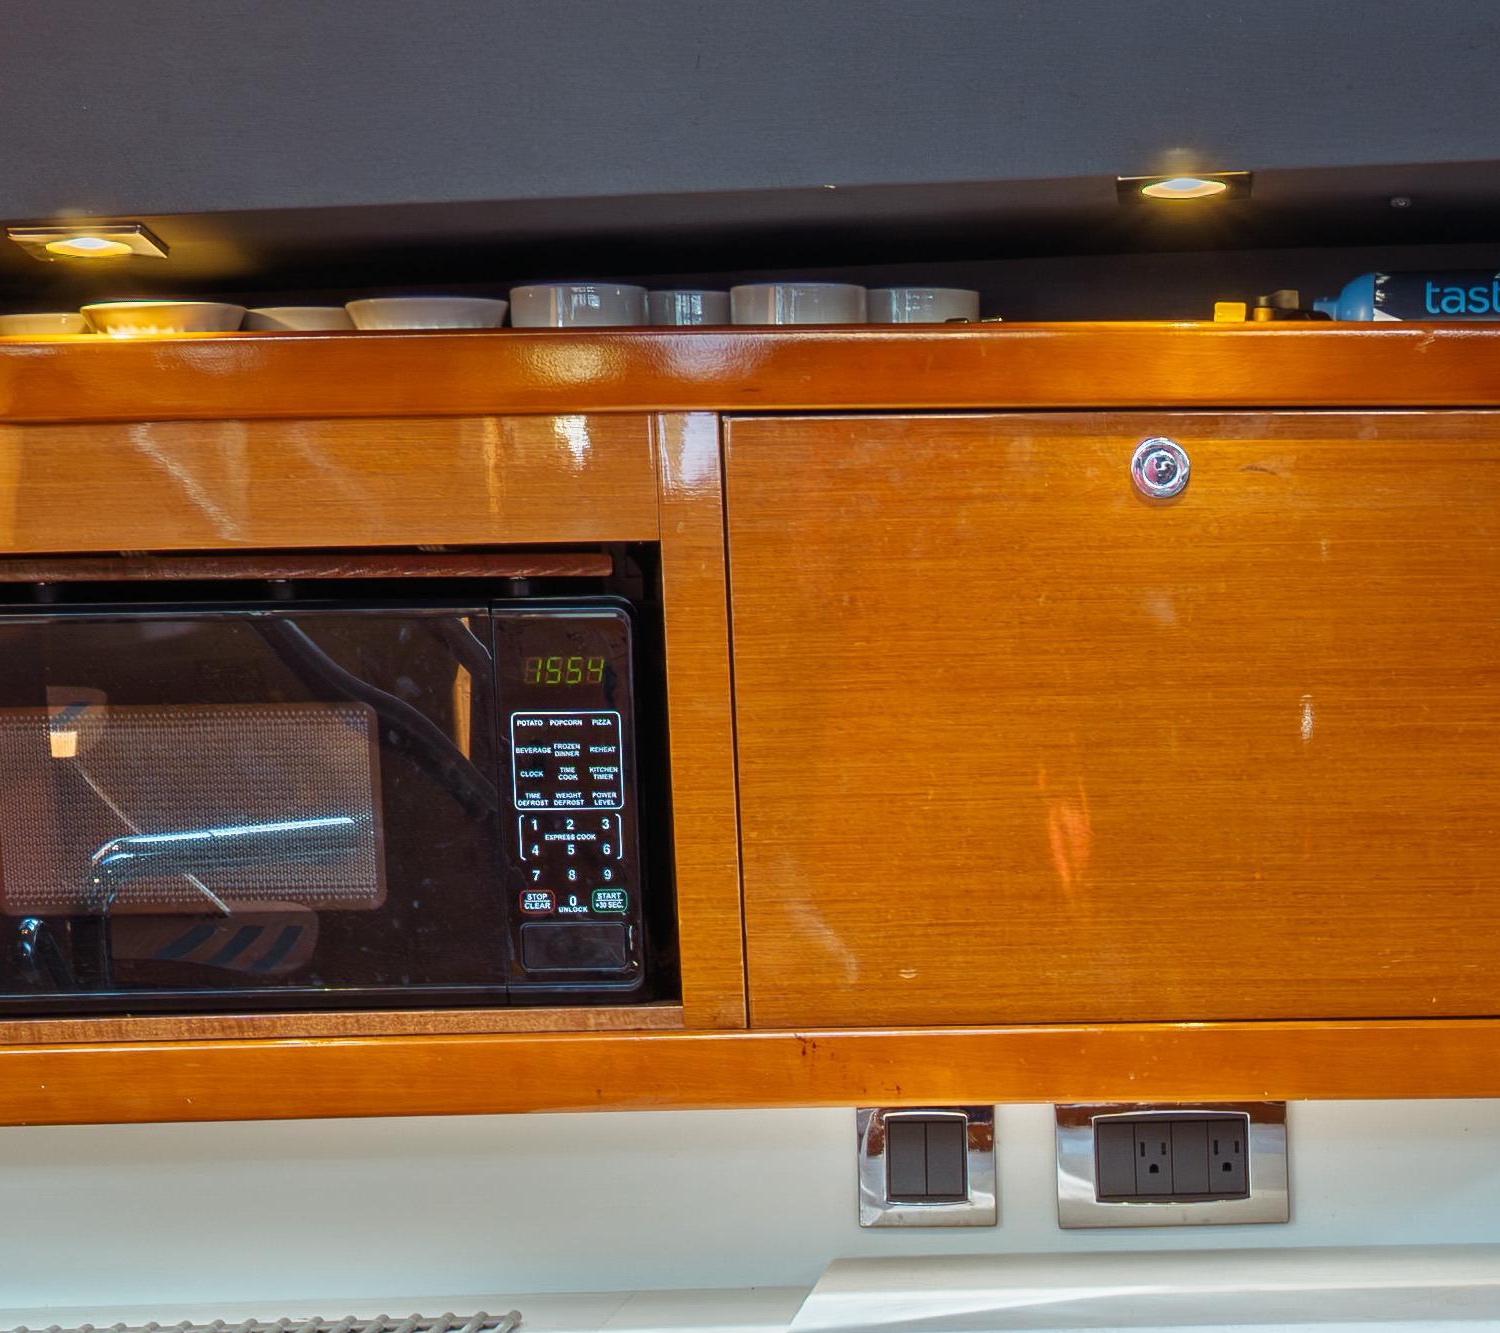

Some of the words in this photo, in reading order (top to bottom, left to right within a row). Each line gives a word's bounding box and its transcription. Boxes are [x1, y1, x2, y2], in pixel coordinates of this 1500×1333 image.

[535, 656, 605, 684] 1554
[516, 719, 543, 727] POTATO
[549, 719, 583, 727] POPCORN
[591, 718, 612, 726] PIZZA
[520, 770, 544, 778] CLOCK
[557, 773, 579, 781] COOK
[517, 799, 549, 807] DEFROST
[566, 819, 575, 830] 2
[601, 818, 610, 830] 3
[544, 833, 575, 841] EXPRESS
[531, 844, 539, 856] 4
[567, 844, 575, 855] 5
[602, 844, 611, 855] 6
[532, 870, 540, 881] 7
[568, 869, 576, 881] 8
[603, 869, 612, 880] 9
[524, 902, 551, 910] CLEAR
[569, 895, 577, 906] 0
